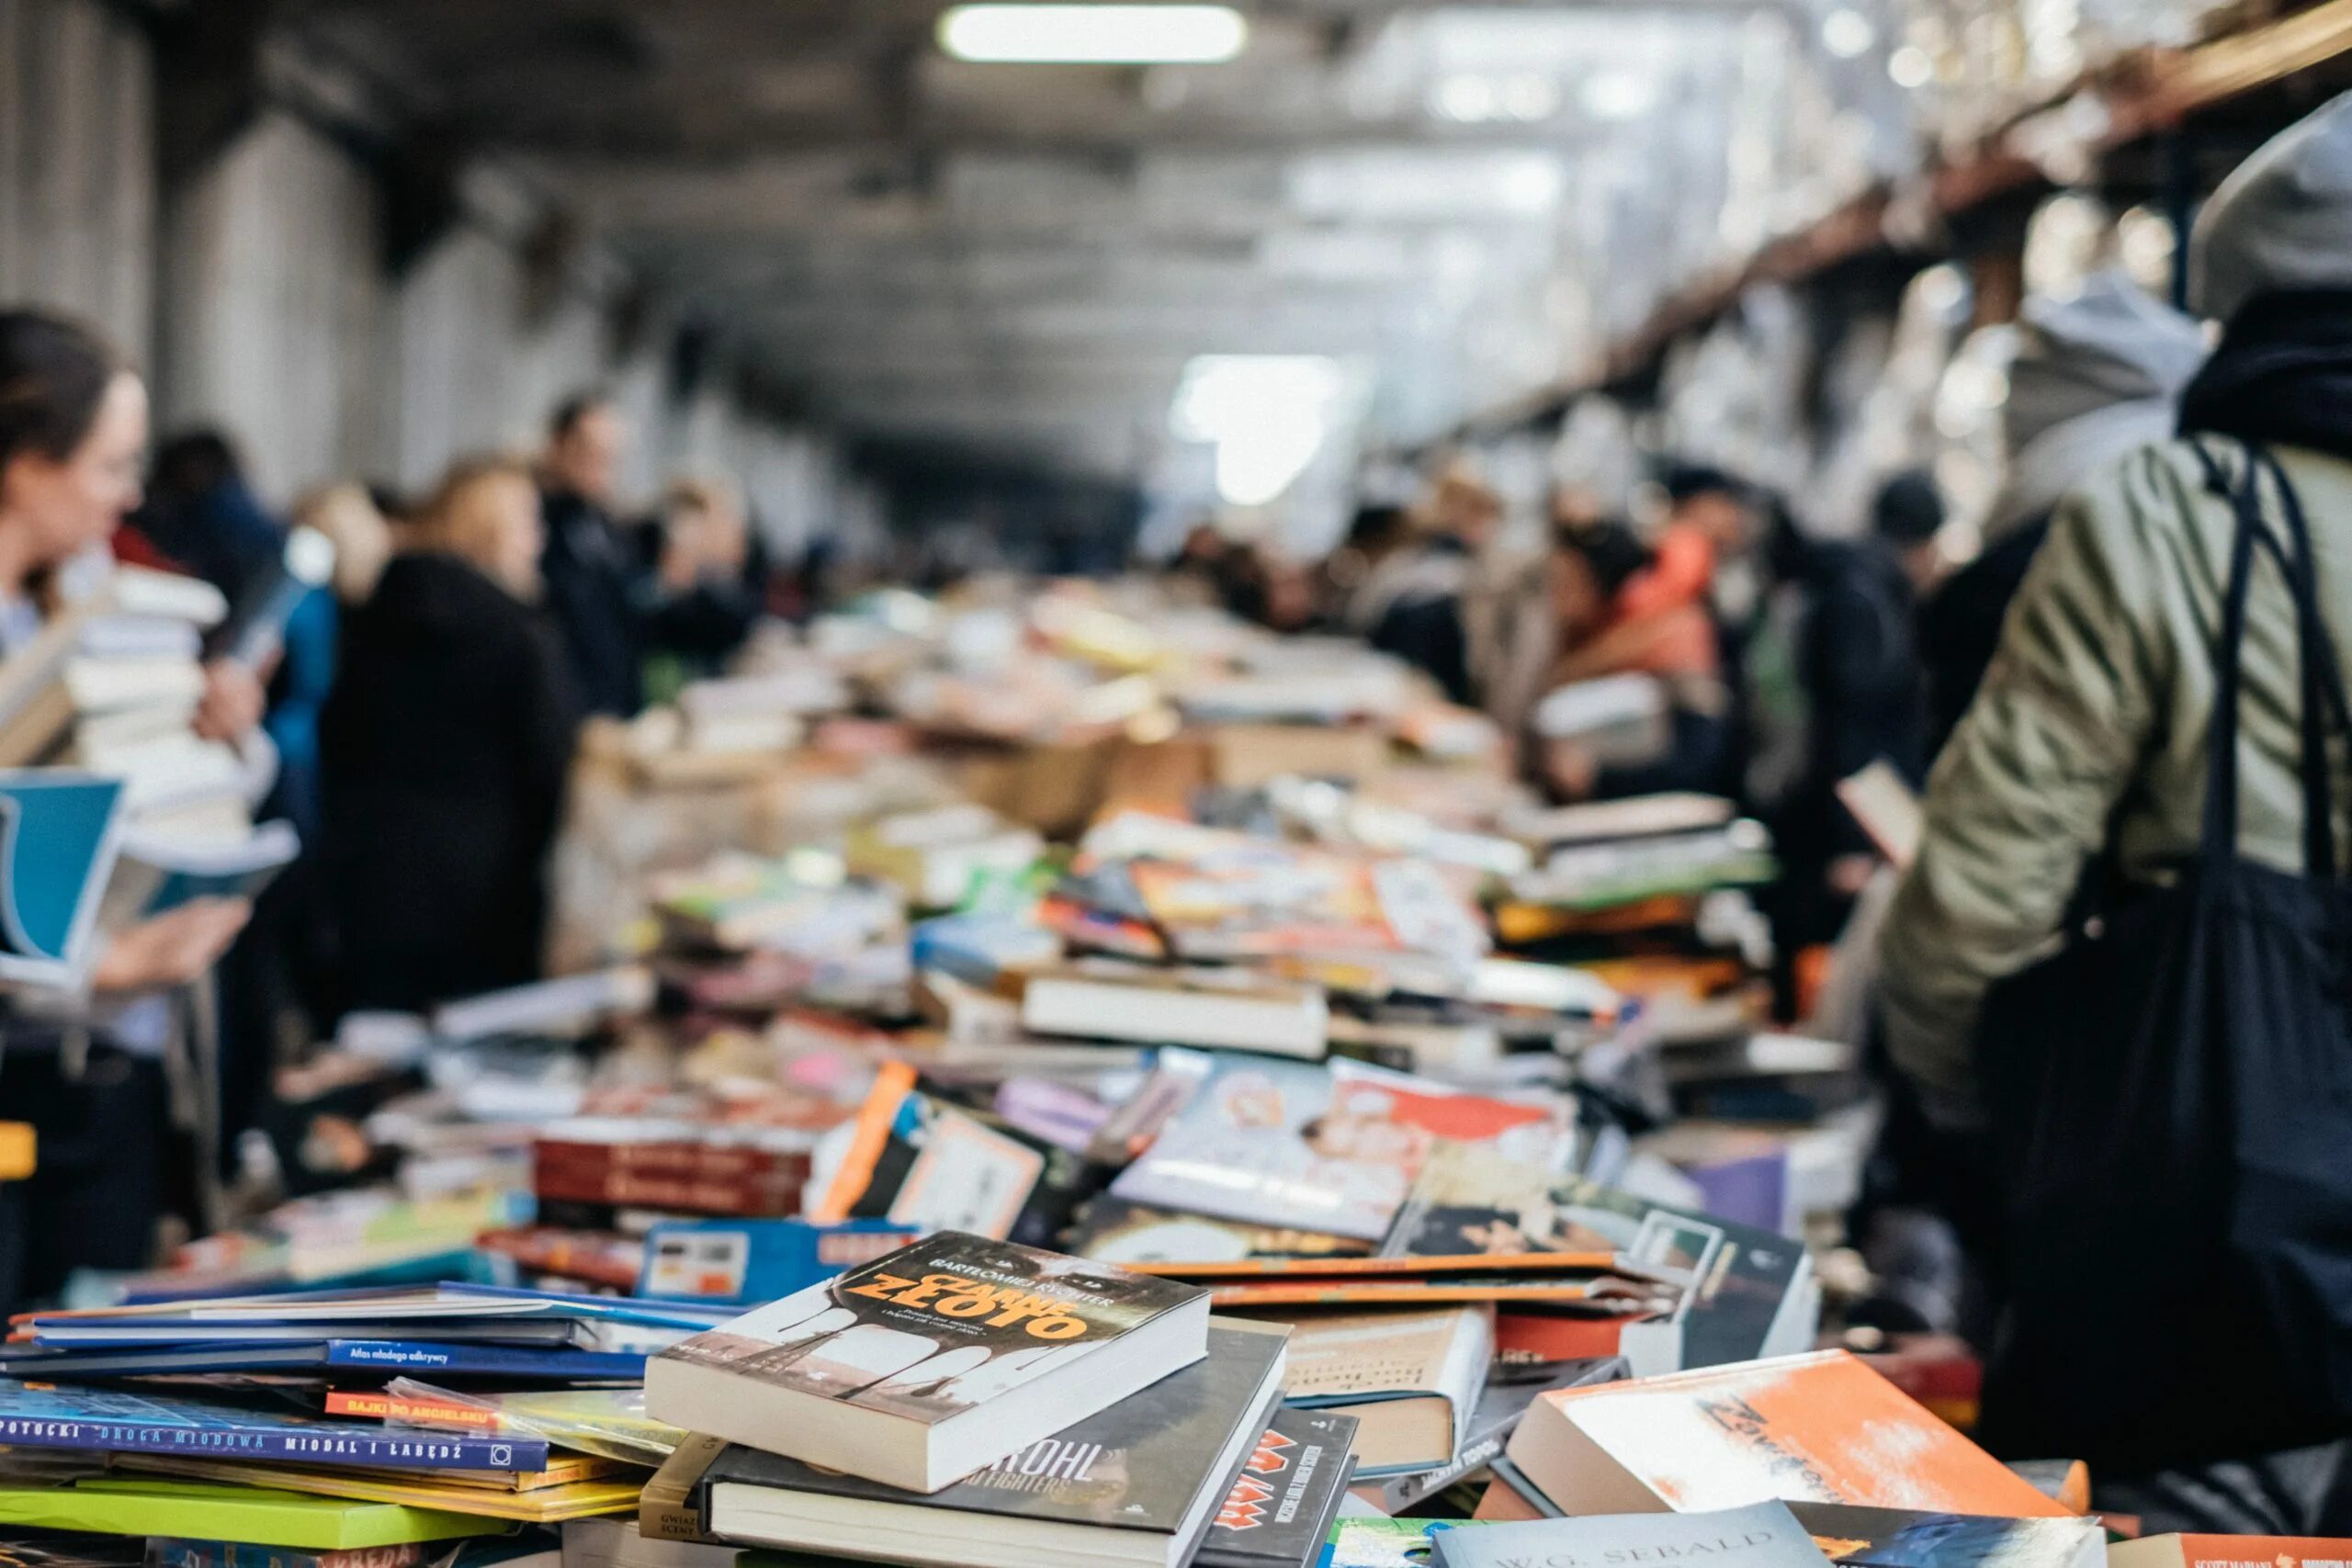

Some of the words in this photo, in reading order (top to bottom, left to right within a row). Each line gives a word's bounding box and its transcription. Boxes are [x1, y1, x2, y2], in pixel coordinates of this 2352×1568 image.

[845, 1273, 1088, 1339] ZŁOTO
[920, 1273, 1079, 1316] CZARNE
[350, 1348, 370, 1359] Atlas
[372, 1348, 407, 1362] młodego
[347, 1400, 387, 1414] BAJKI
[390, 1403, 409, 1416] PO
[412, 1406, 488, 1424] ANGIELSKU
[101, 1427, 161, 1441] DROGA
[175, 1430, 264, 1448] MIODOWA
[390, 1443, 461, 1460] ŁABĘDŹ
[984, 1471, 1072, 1495] FIGHTERS
[662, 1514, 695, 1525] GWIAZ
[1603, 1531, 1773, 1563] SEBALD
